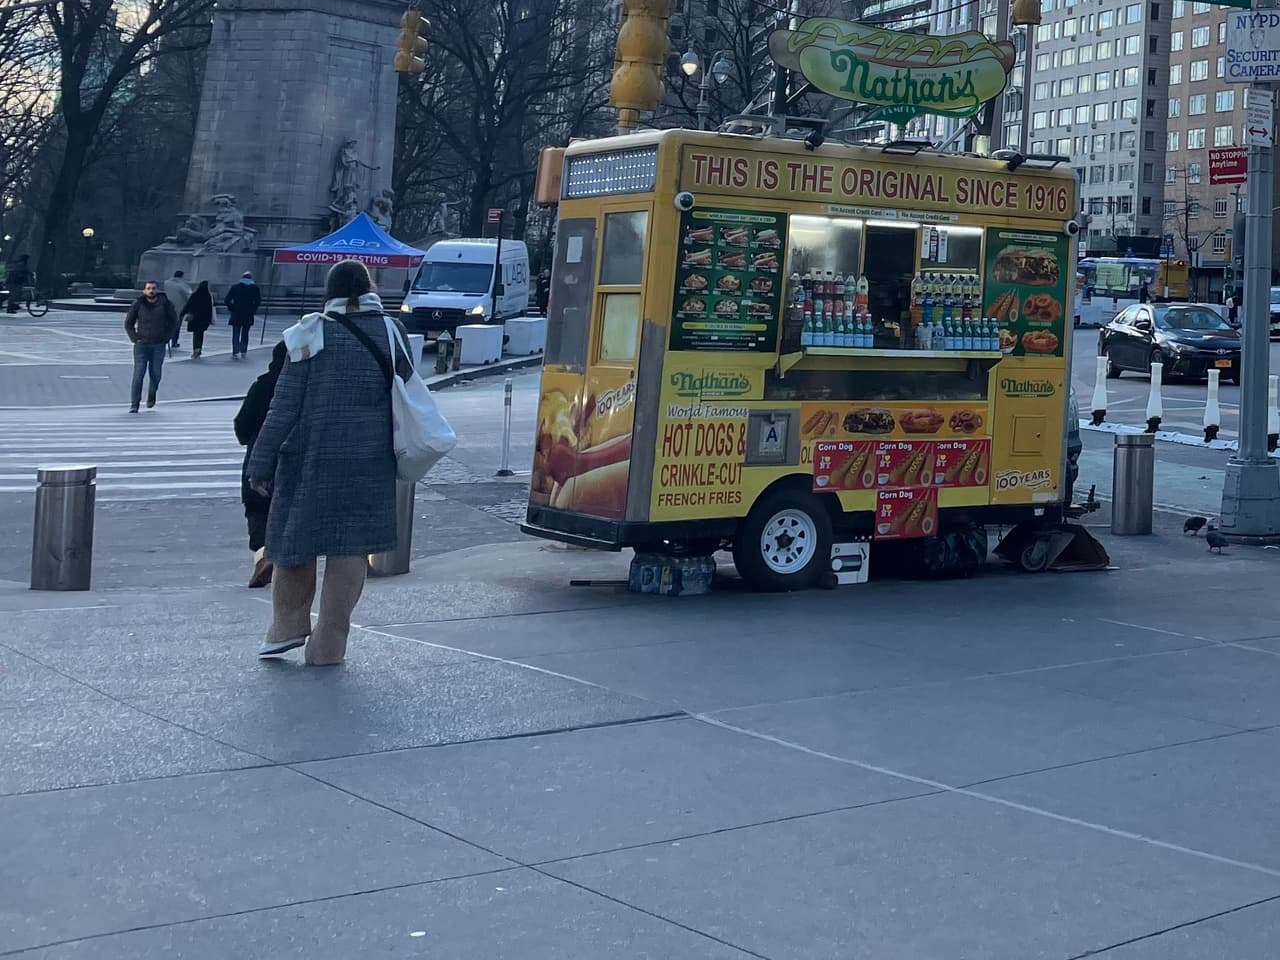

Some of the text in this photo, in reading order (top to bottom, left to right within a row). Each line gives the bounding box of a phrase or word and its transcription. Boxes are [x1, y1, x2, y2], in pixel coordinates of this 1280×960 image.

[1236, 14, 1280, 29] NYPD
[829, 48, 979, 108] Nathan's
[1210, 152, 1220, 160] NO
[1211, 160, 1238, 168] Anytime
[691, 154, 1067, 212] THIS IS THE ORIGINAL SINCE 1916
[296, 253, 388, 265] COVID-19 TESTING
[670, 371, 751, 394] Nathan's
[1001, 378, 1054, 395] Nathan's
[667, 404, 749, 418] World Famous
[662, 422, 747, 457] HOT DOGS &
[766, 427, 778, 443] A
[818, 442, 853, 452] Corn Dog
[880, 442, 913, 451] Corn Dog
[953, 441, 966, 450] Dog
[660, 462, 745, 488] CRINKLE-CUT
[995, 469, 1050, 490] 100 YEARS
[657, 491, 742, 507] FRENCH FRIES
[880, 490, 913, 499] Corn Dog
